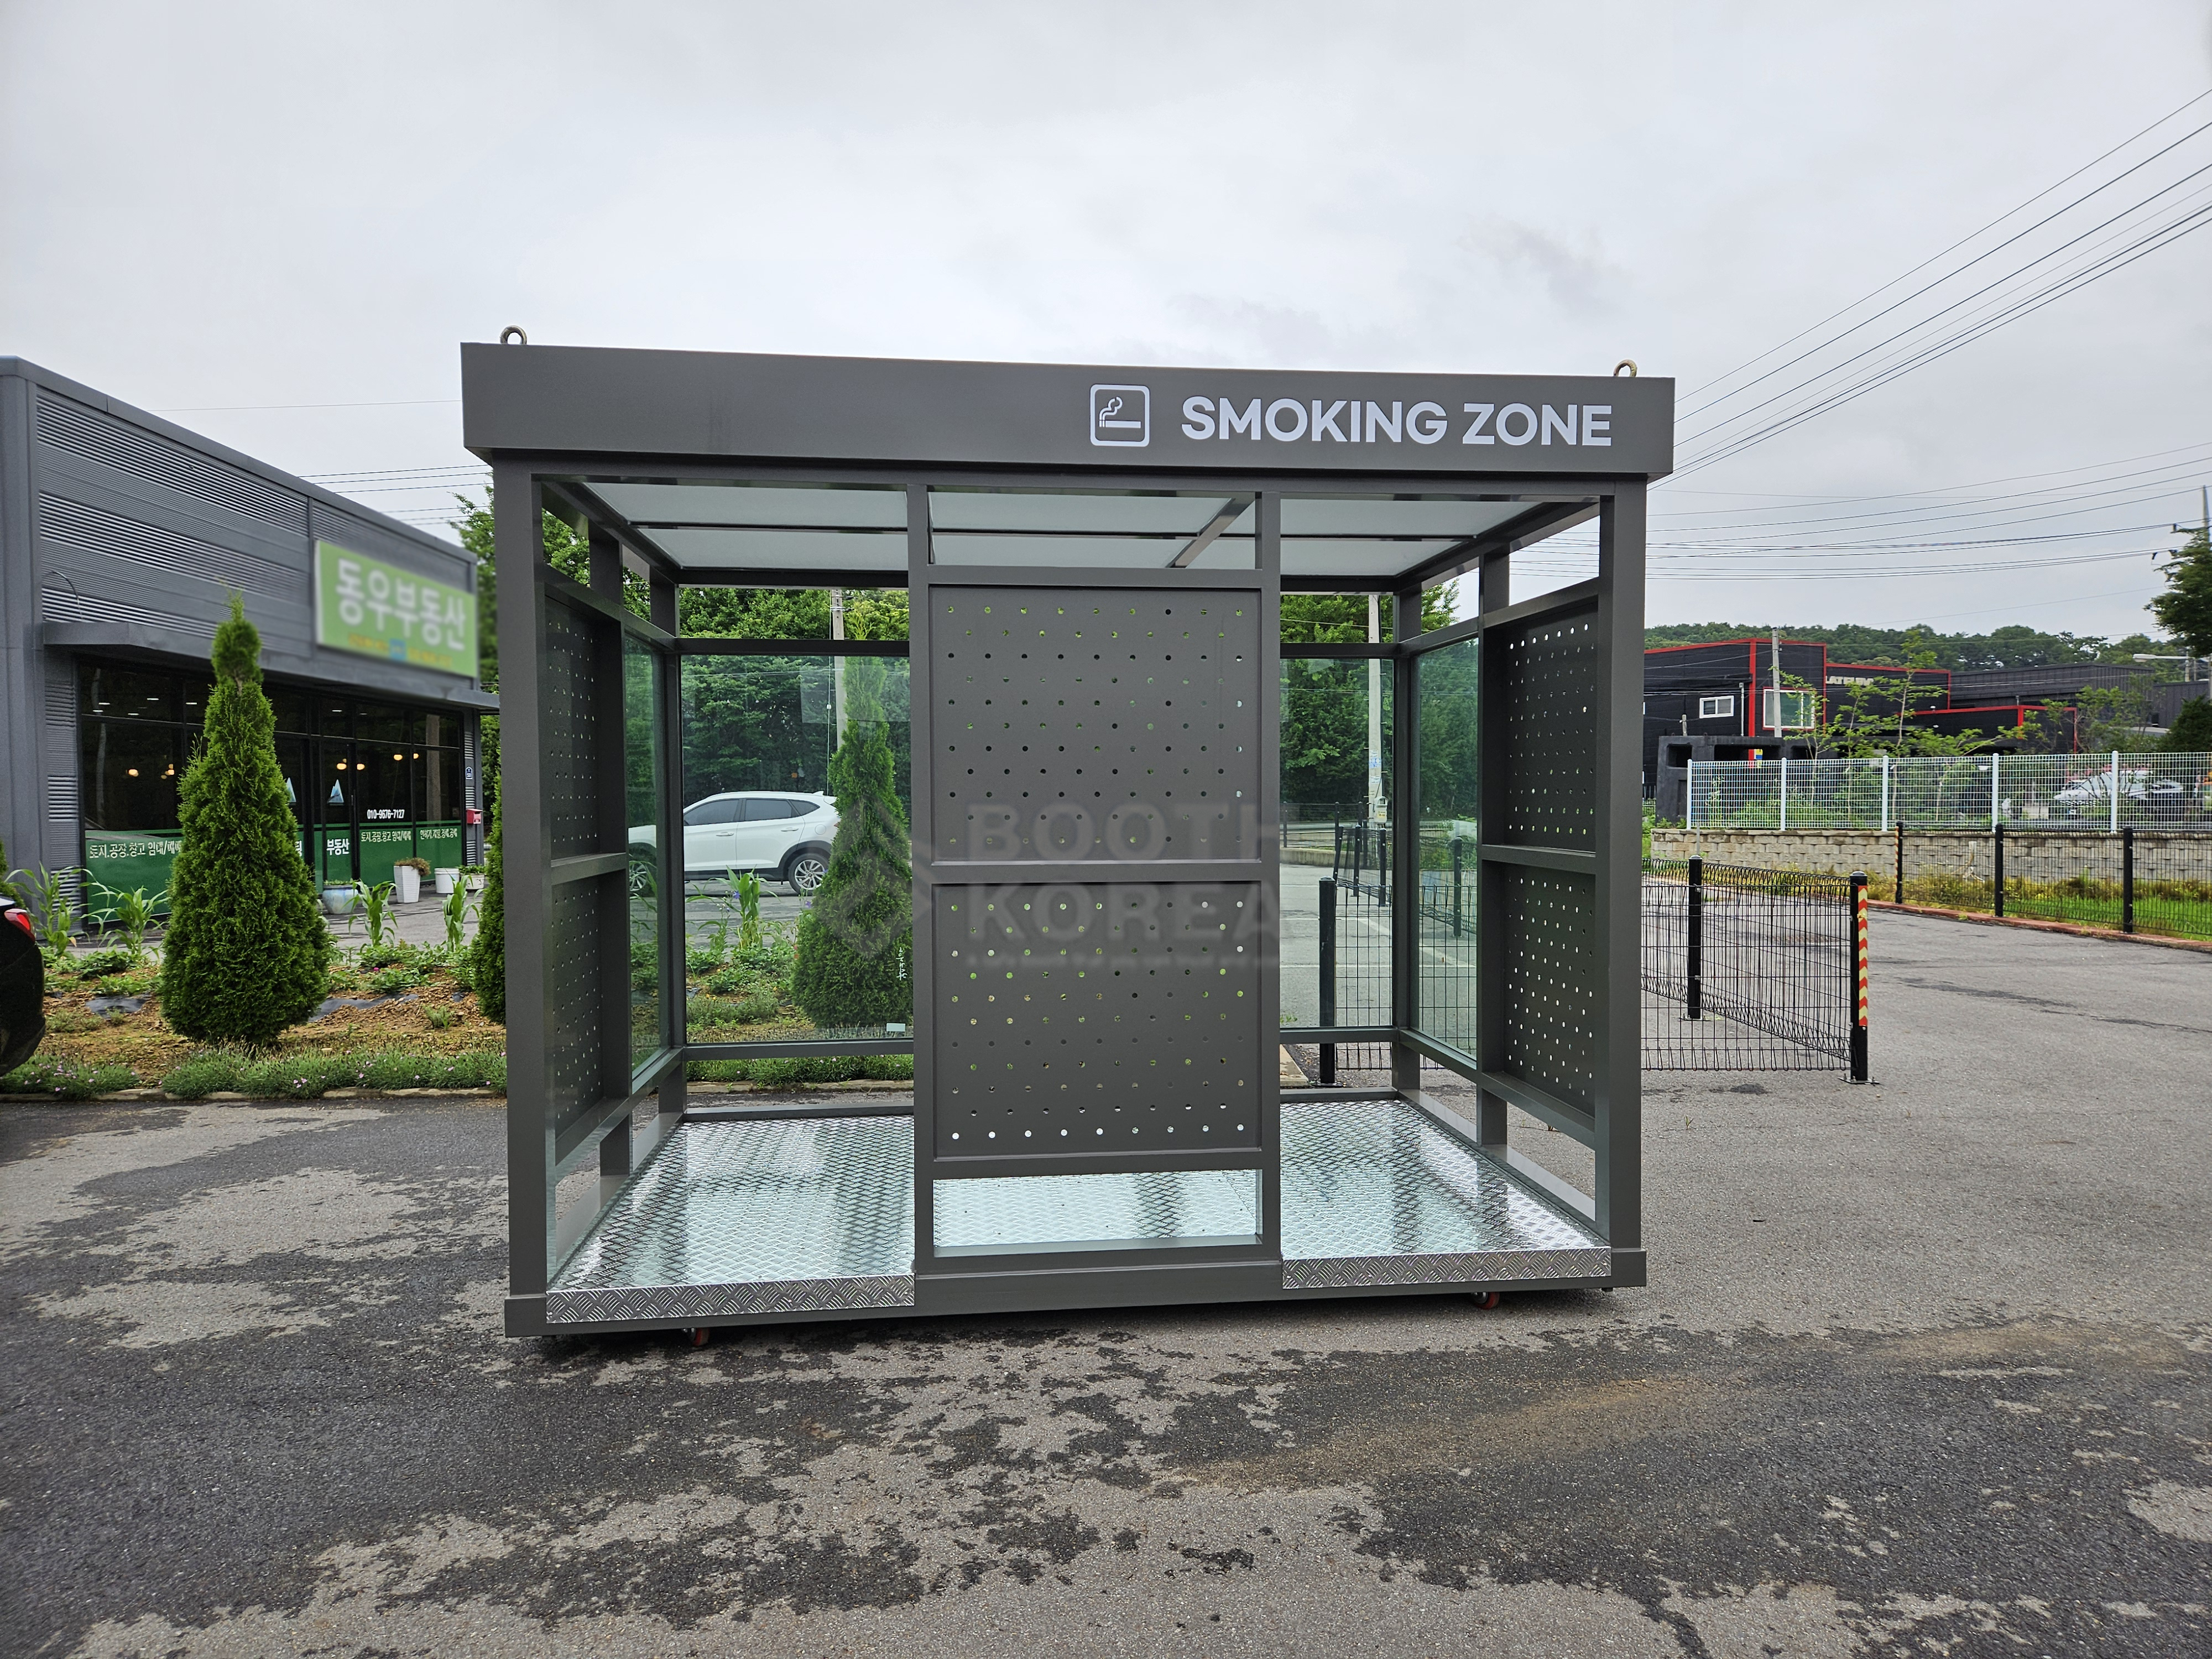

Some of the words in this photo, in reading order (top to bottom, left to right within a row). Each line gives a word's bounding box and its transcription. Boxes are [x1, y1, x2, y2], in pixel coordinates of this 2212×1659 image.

[1181, 395, 1447, 445] SMOKING
[1462, 402, 1612, 446] ZONE
[335, 557, 466, 651] 동우부동산
[367, 808, 405, 820] 010-9676-7127
[89, 842, 146, 859] 토지.공장.창고
[326, 838, 349, 855] 부동산
